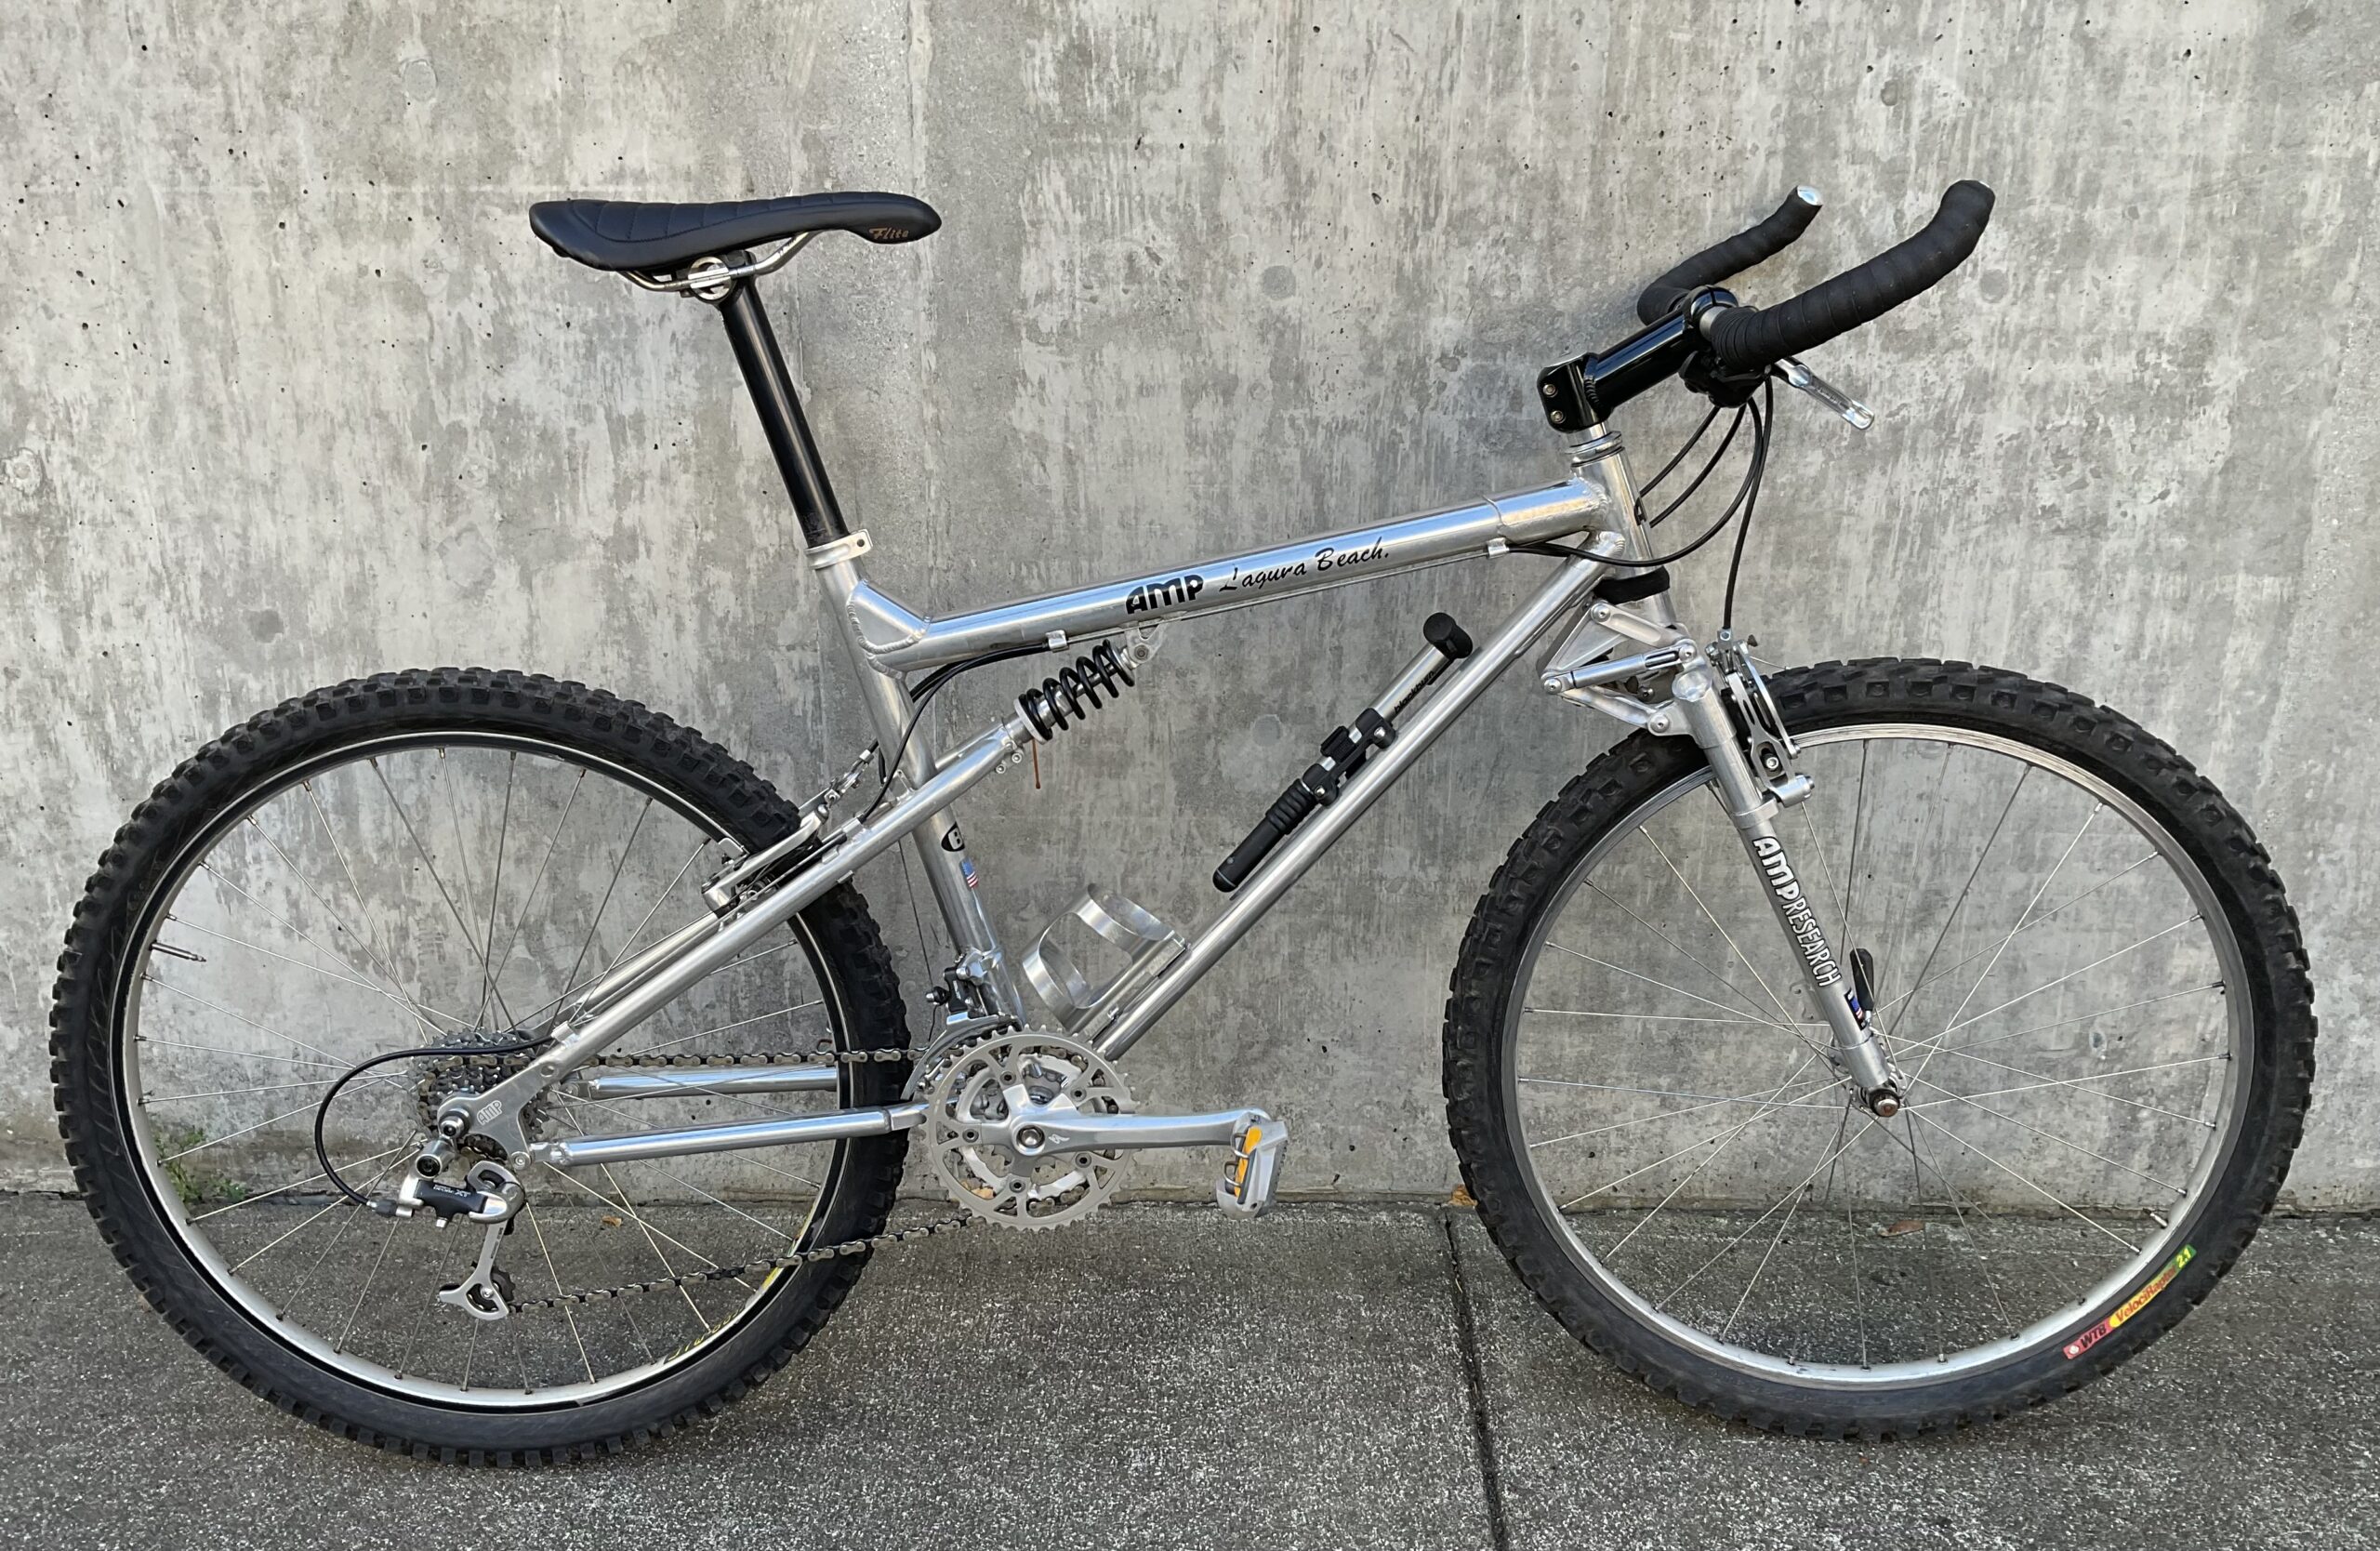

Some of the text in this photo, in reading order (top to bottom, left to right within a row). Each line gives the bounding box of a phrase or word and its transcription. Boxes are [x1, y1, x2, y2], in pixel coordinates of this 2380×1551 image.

[1125, 574, 1204, 614] AMP
[1752, 836, 1842, 988] AMP RESEARCH
[477, 1100, 503, 1125] AMP
[2080, 1248, 2192, 1348] WTB VelociRaptor 2.1
